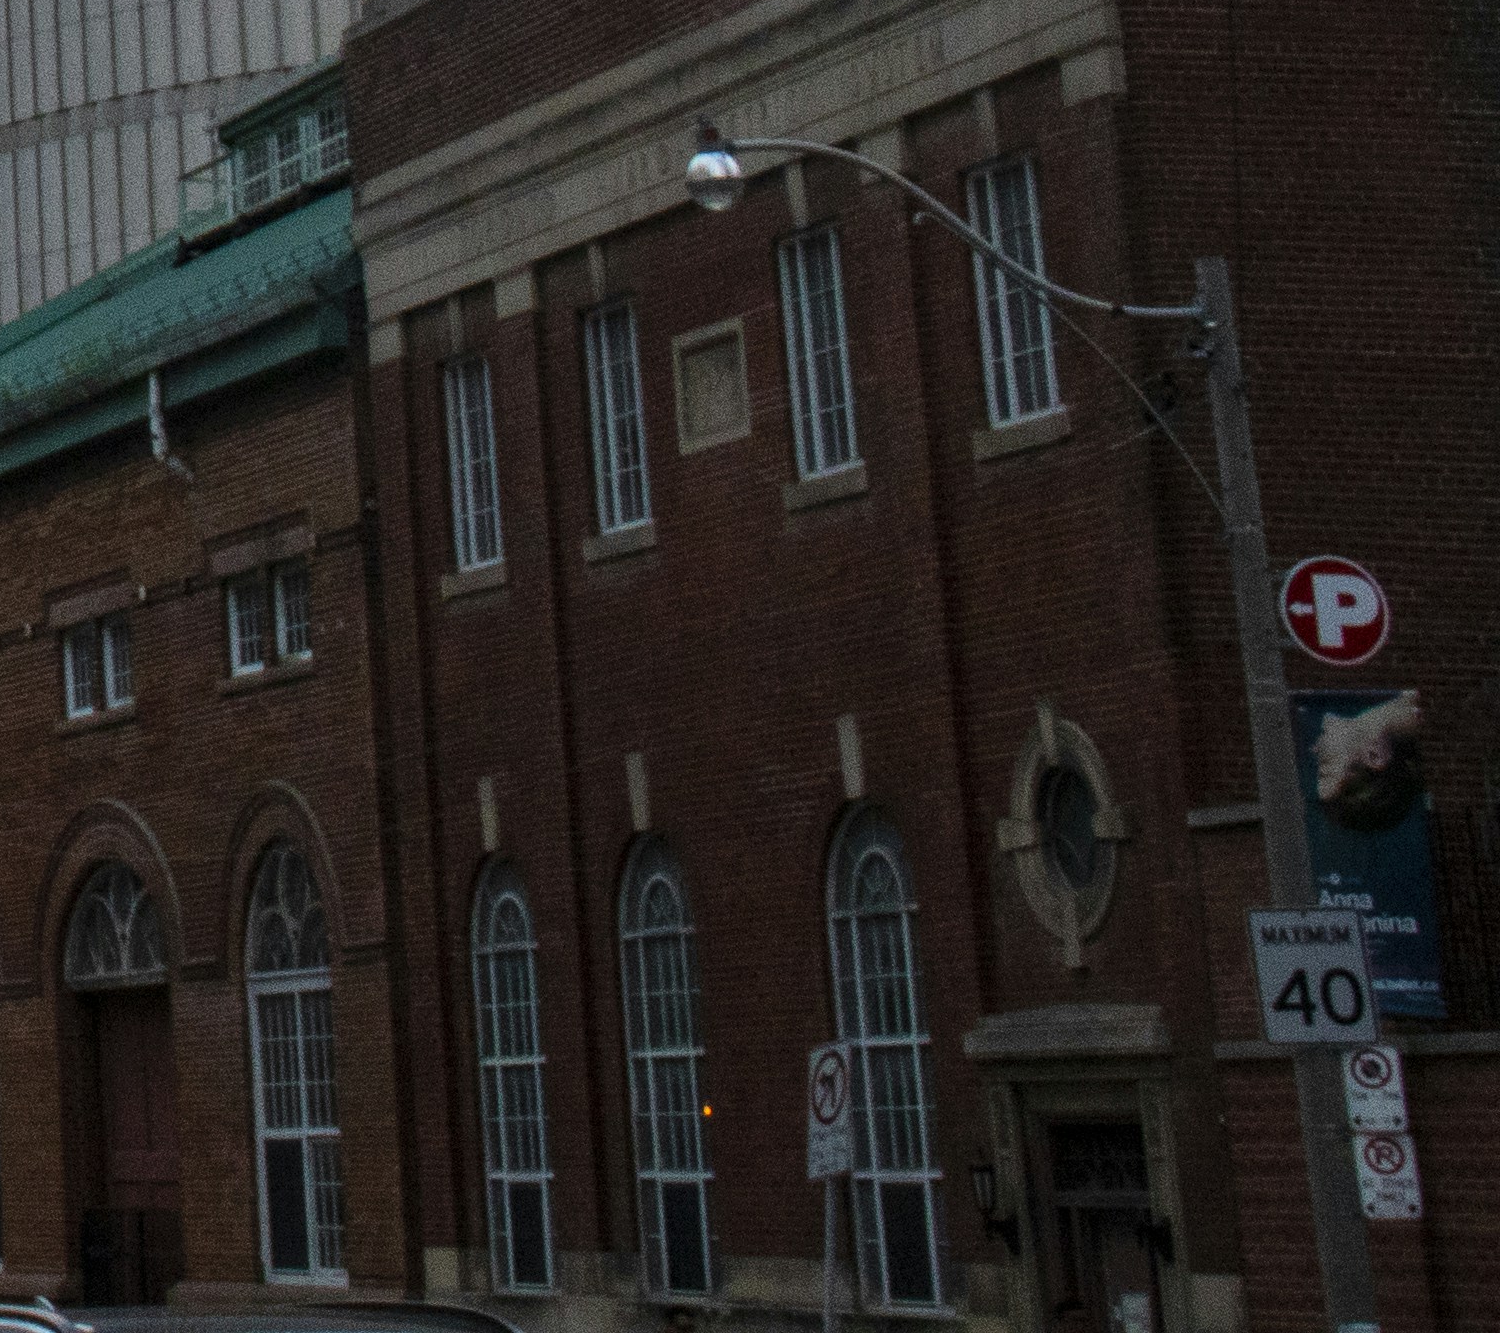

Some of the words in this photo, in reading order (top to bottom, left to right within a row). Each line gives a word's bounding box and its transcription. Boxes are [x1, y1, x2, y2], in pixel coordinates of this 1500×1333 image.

[1311, 572, 1379, 648] P
[1319, 889, 1374, 910] Anna
[1261, 925, 1351, 945] MAXIMUM
[1271, 967, 1365, 1026] 40
